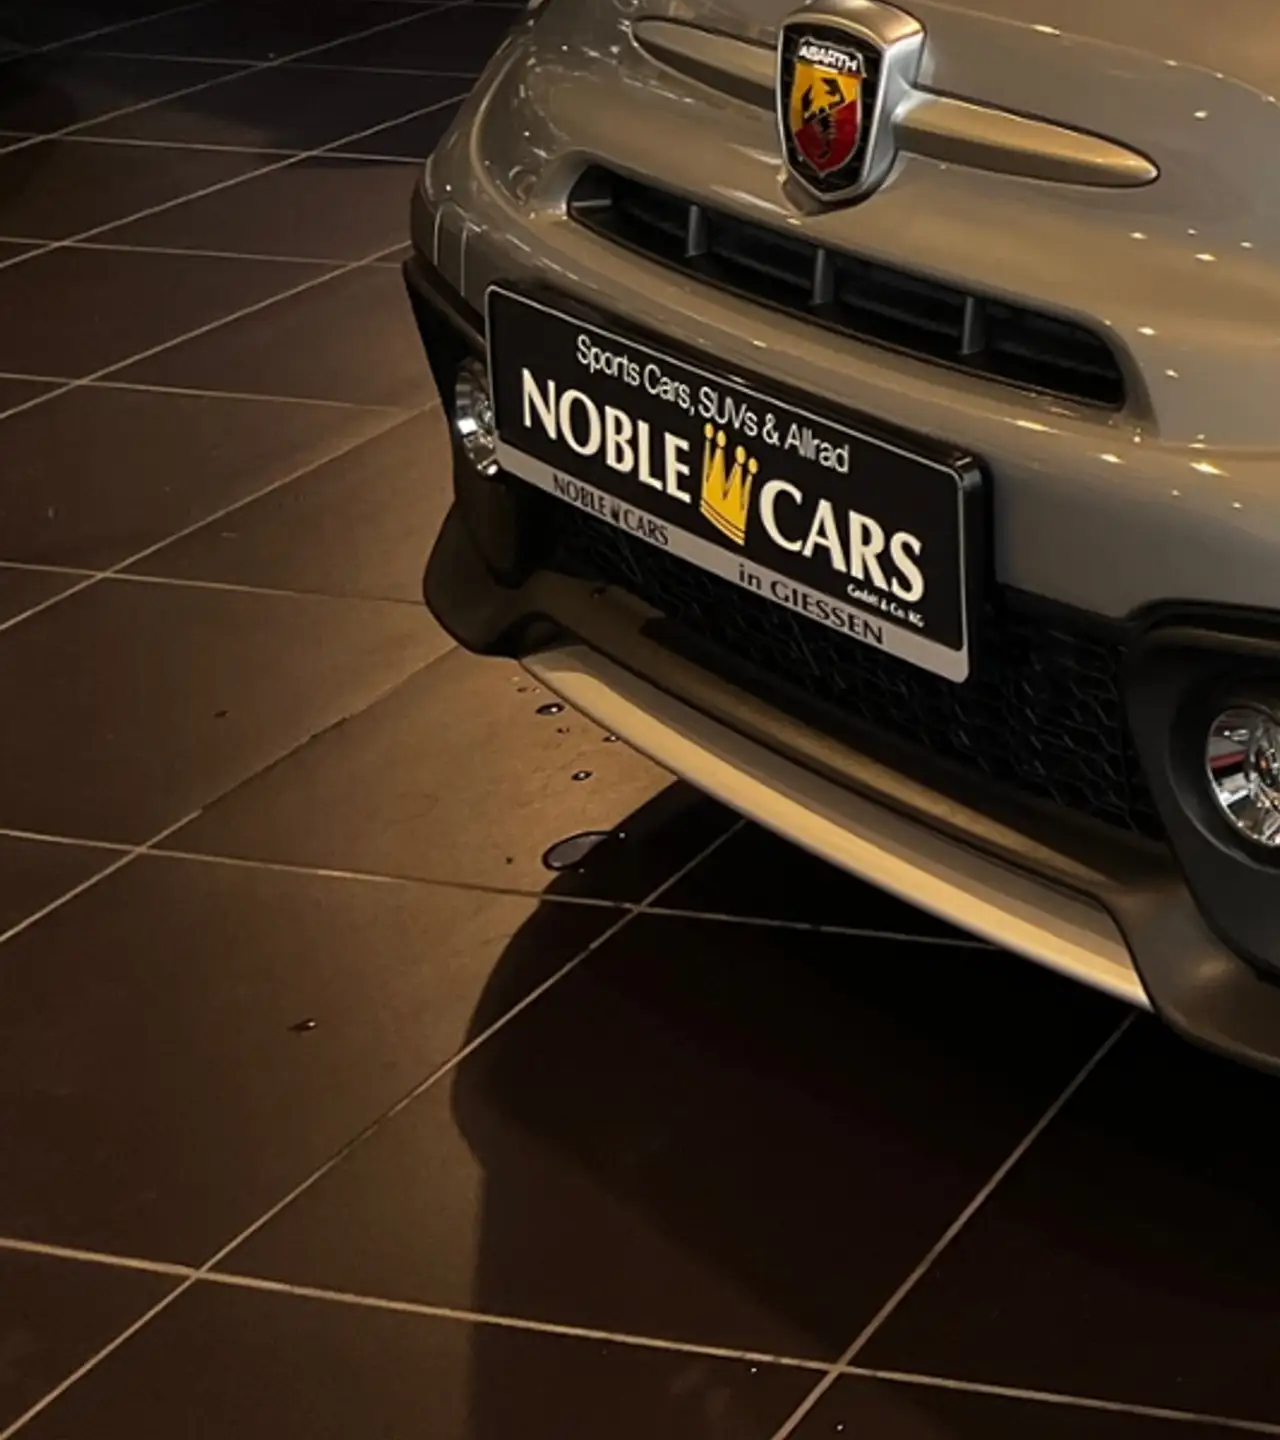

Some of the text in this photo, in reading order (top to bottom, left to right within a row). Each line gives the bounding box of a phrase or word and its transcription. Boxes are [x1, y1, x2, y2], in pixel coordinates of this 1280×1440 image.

[799, 44, 858, 71] ABARTH
[576, 334, 850, 474] Sports Cars, SUVs & Allrad
[521, 366, 925, 603] NOBLE CARS
[552, 472, 669, 546] NOBLE CARS
[738, 562, 884, 646] in GIESSEN
